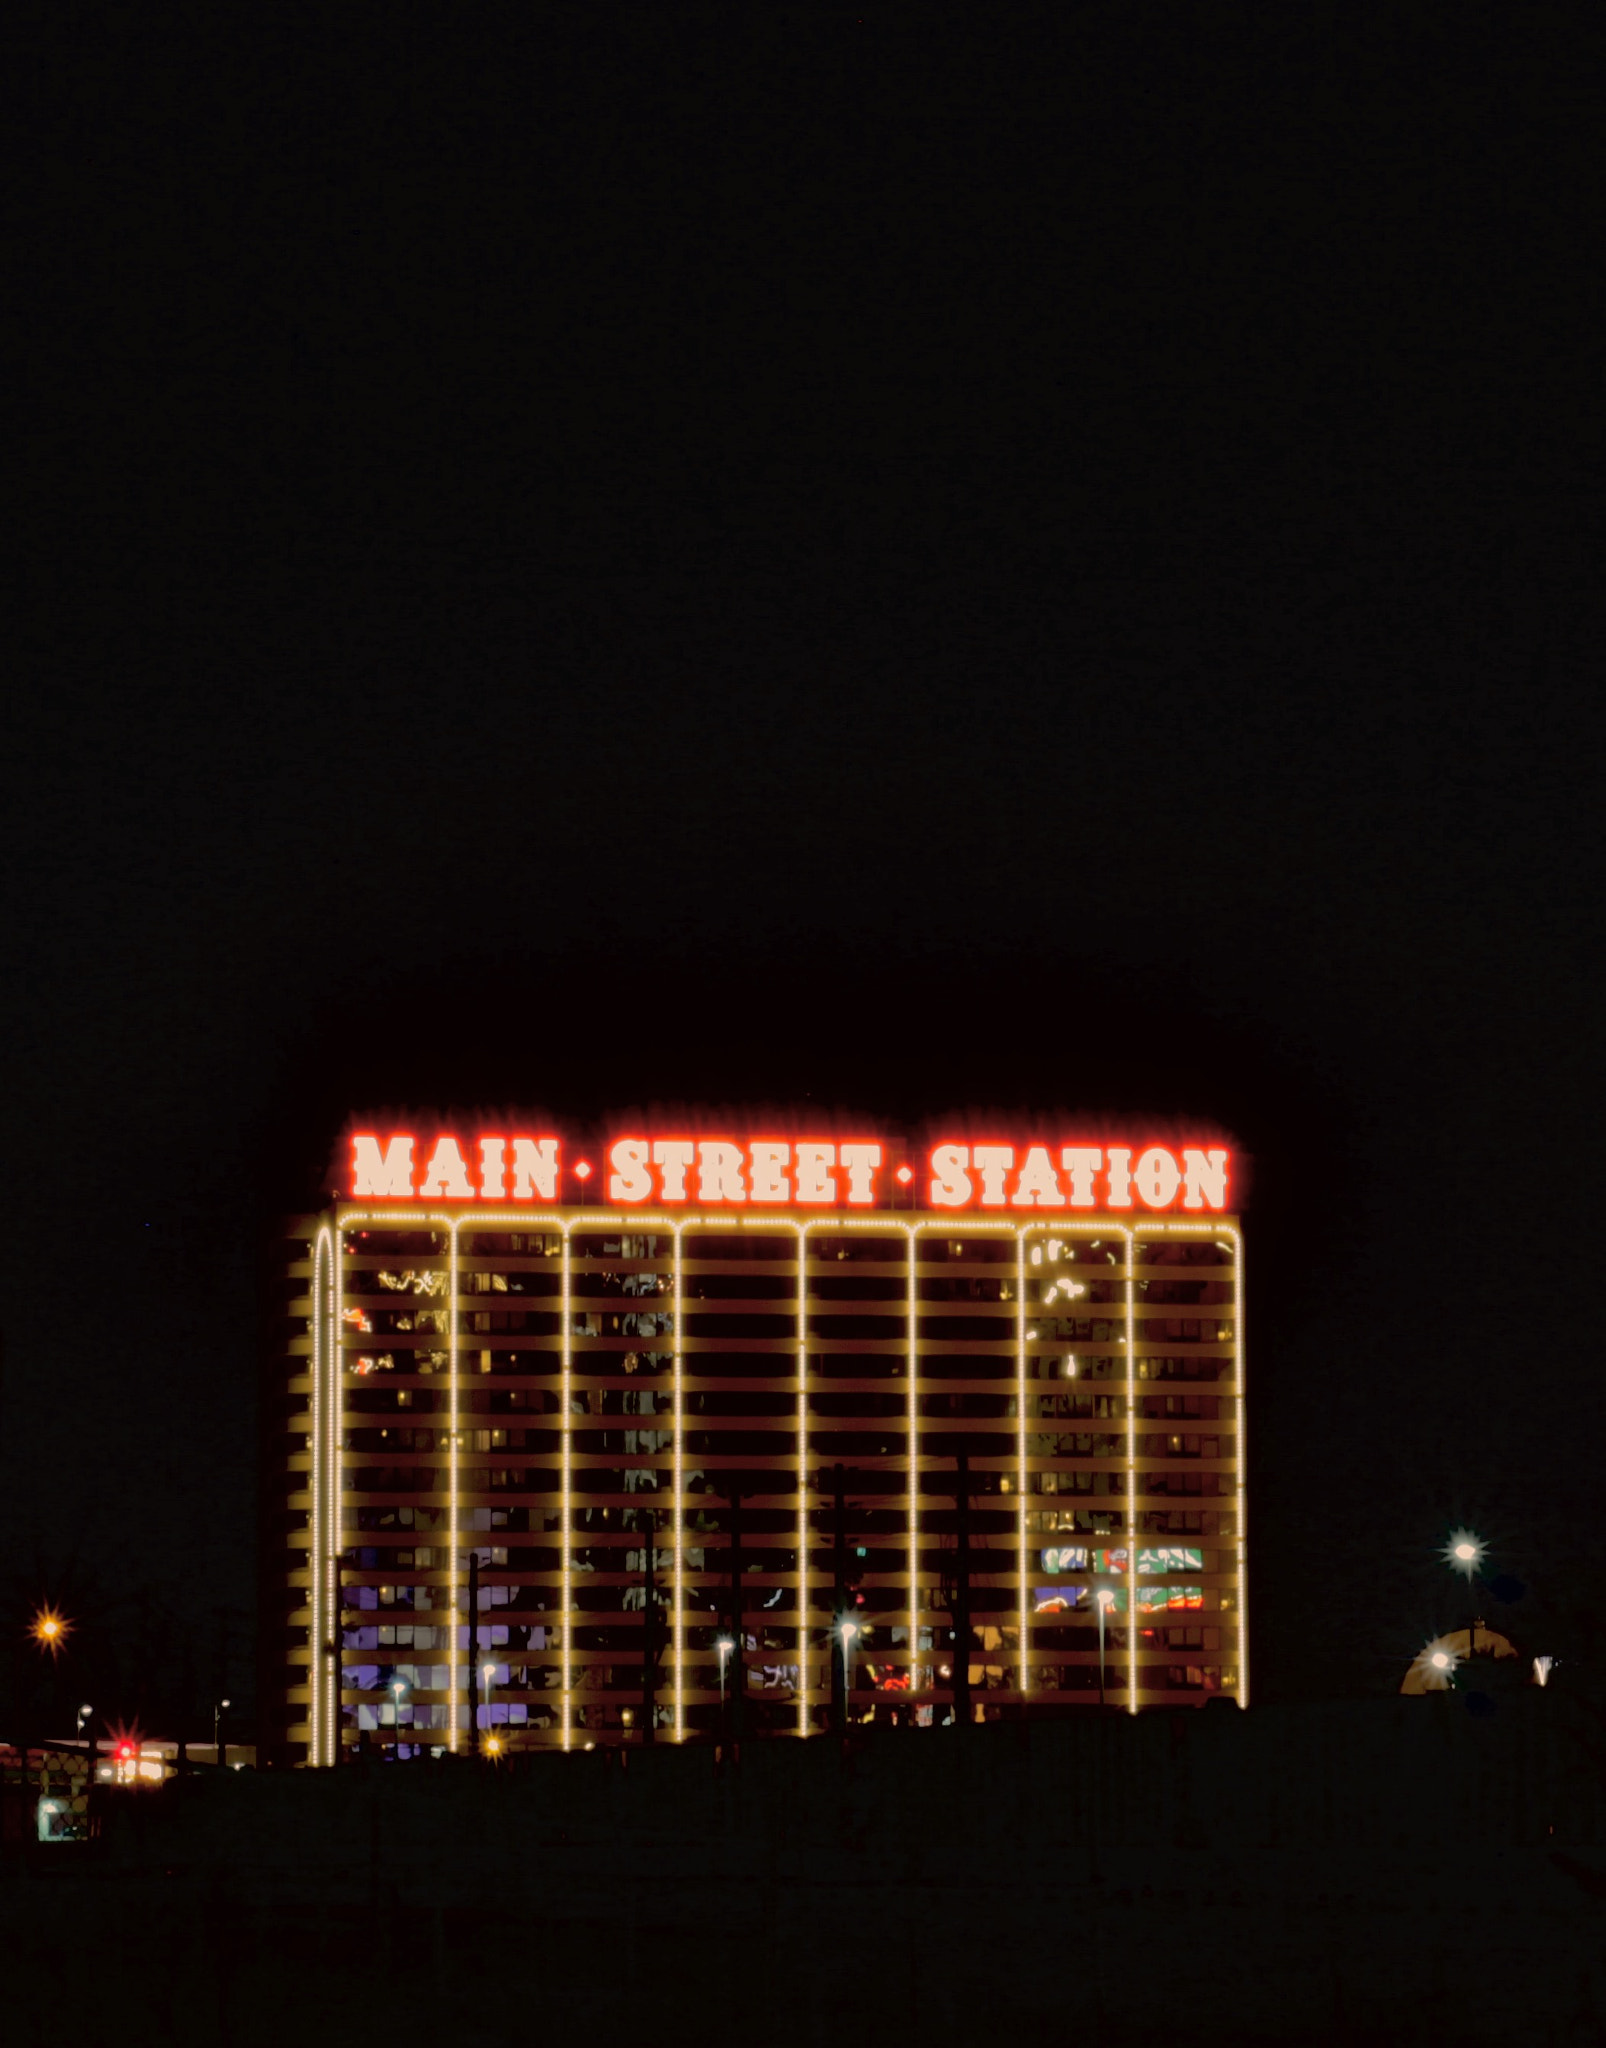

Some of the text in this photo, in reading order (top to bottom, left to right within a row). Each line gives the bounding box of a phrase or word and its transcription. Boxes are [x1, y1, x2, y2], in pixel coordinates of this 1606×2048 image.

[352, 1136, 1227, 1208] MAIN STREET STATION
